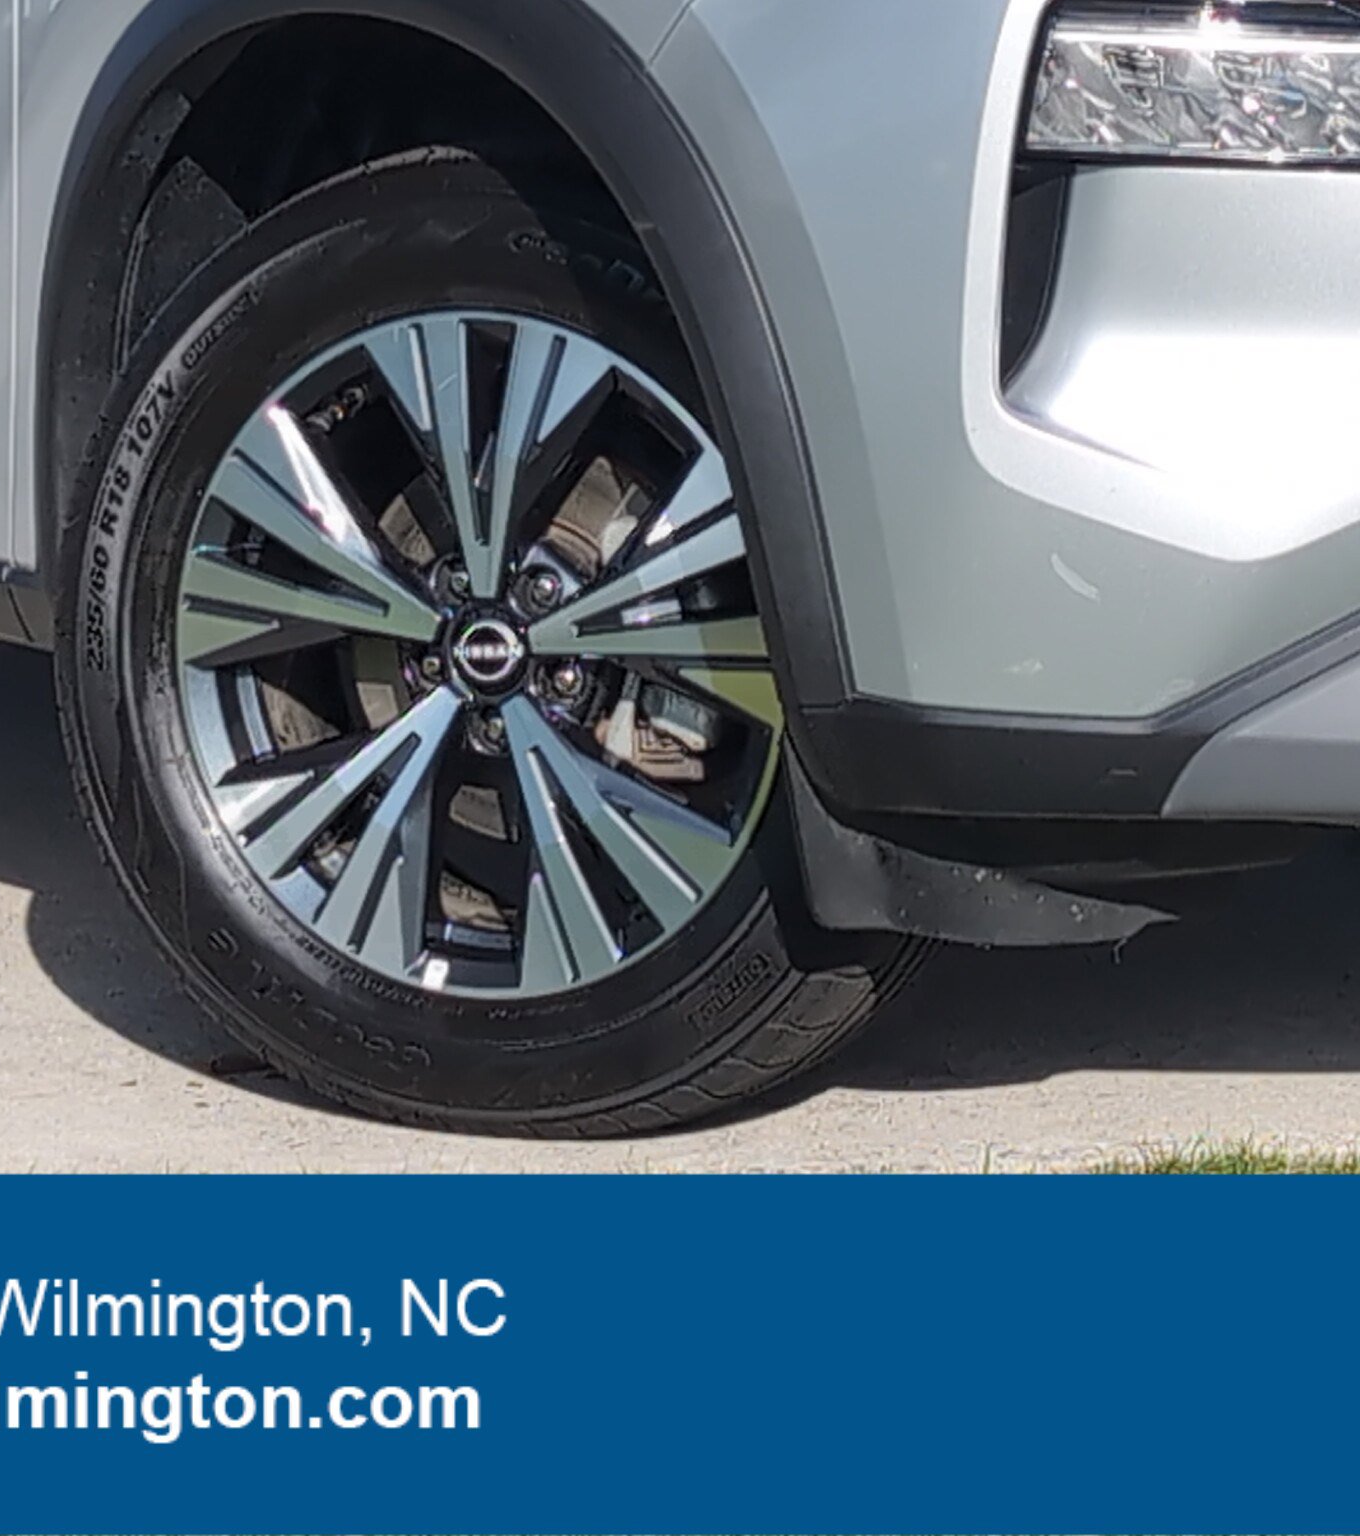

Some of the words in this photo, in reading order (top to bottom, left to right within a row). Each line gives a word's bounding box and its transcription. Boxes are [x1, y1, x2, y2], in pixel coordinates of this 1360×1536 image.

[127, 369, 176, 458] 107V
[98, 468, 132, 538] R18
[86, 544, 111, 672] 235/60
